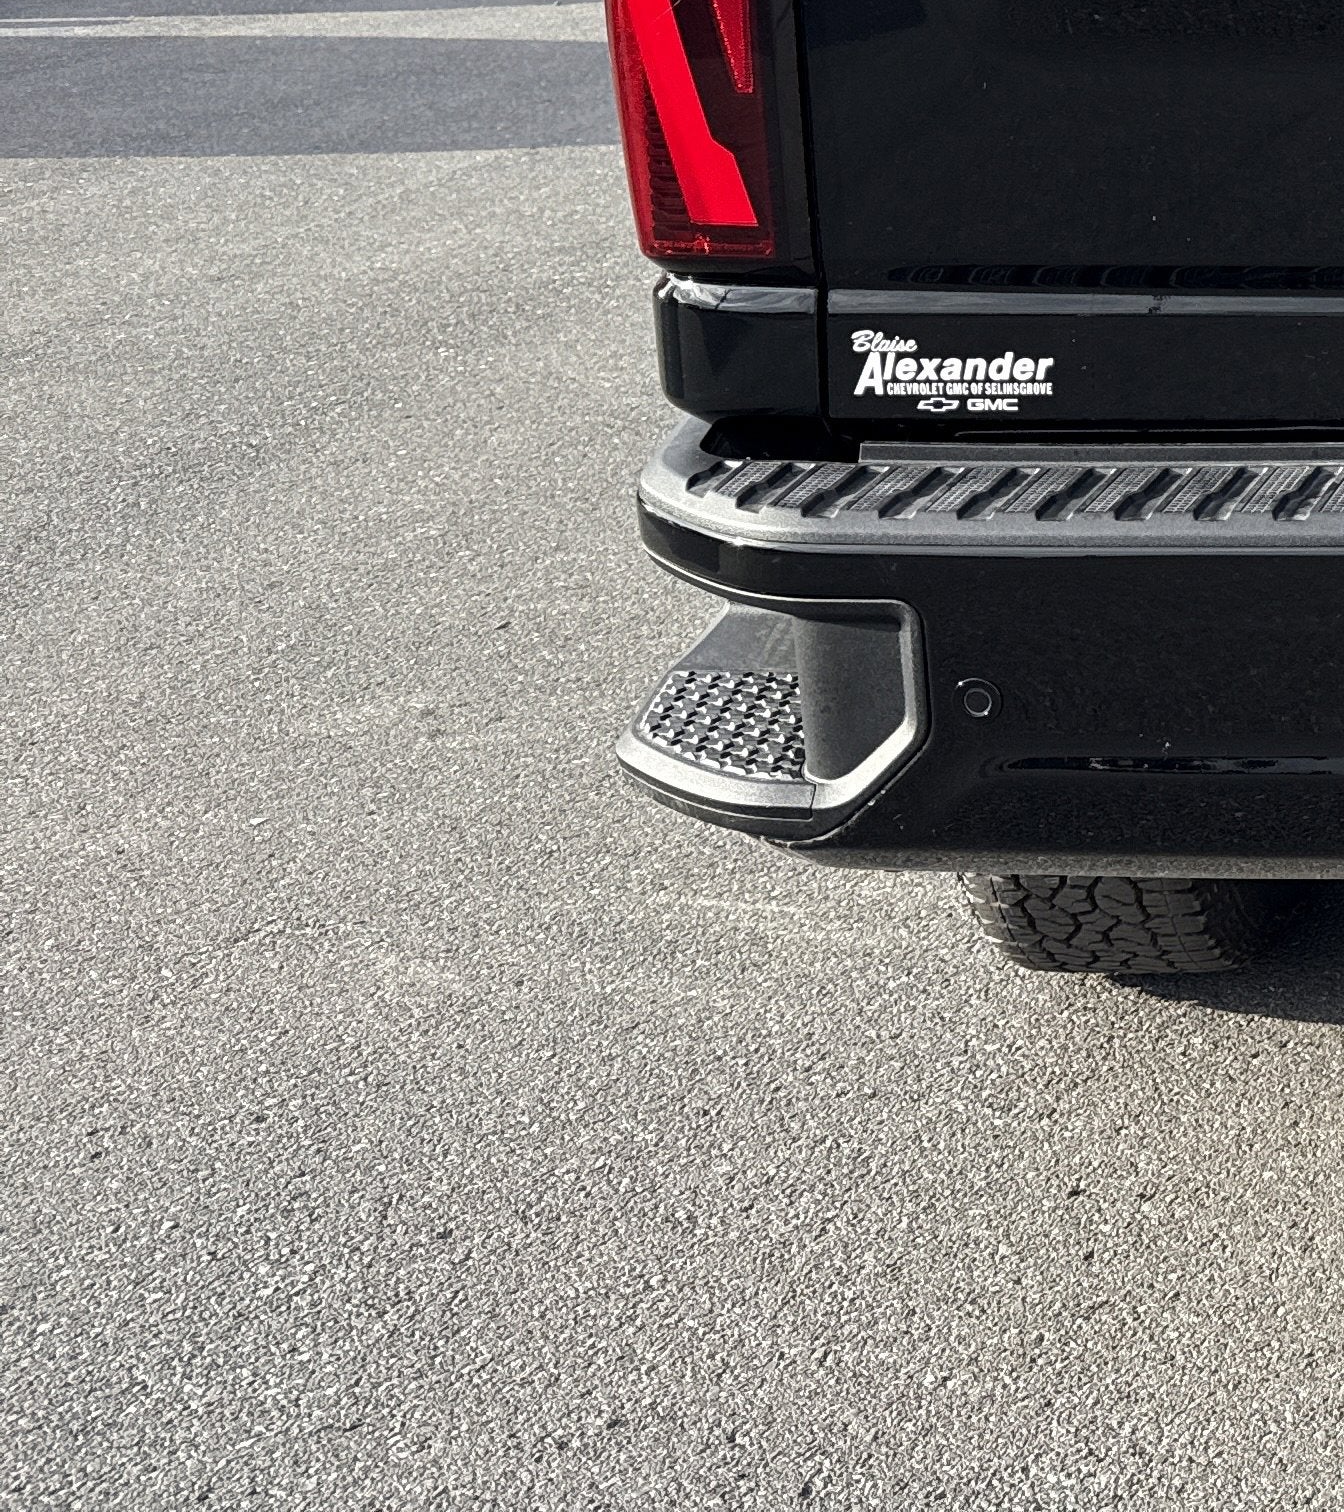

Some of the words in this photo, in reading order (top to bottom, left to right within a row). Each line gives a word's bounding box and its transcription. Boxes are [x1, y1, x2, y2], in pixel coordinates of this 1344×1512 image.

[850, 330, 918, 353] Blaise
[853, 351, 1054, 396] Alexander
[886, 382, 944, 396] CHEVROLET
[946, 382, 969, 396] GMC
[970, 382, 983, 395] OF
[984, 382, 1053, 395] SELINSGROVE
[966, 398, 1019, 411] GMC
